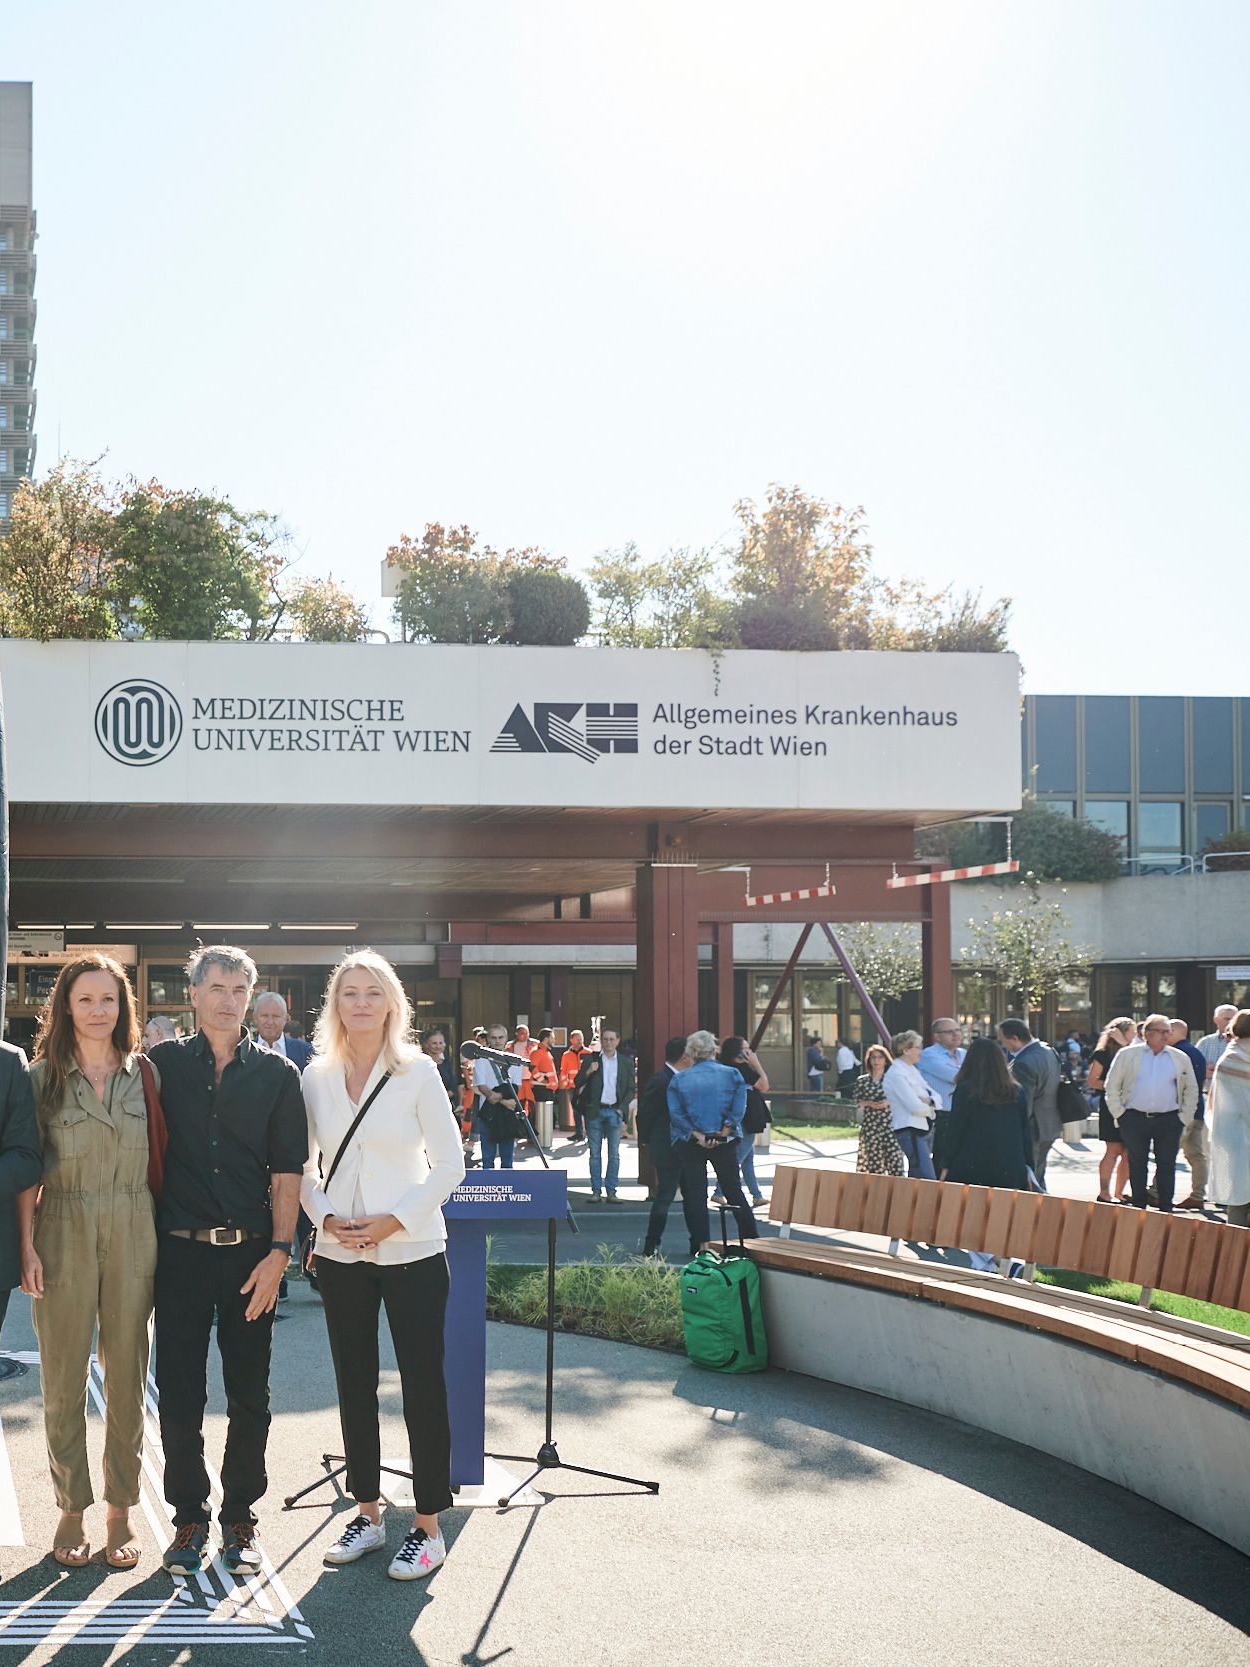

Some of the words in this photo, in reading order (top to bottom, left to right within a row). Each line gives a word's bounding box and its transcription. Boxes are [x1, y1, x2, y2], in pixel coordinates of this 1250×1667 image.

[192, 697, 405, 722] MEDIZINISCHE
[652, 703, 797, 730] Allgemeines
[805, 704, 958, 728] Krankenhaus
[193, 725, 385, 752] UNIVERSITÄT
[392, 730, 472, 753] WIEN
[653, 734, 691, 755] der
[698, 734, 764, 756] Stadt
[769, 735, 827, 757] Wien
[452, 1192, 507, 1202] UNIVERSITÄT
[508, 1194, 531, 1202] WIEN
[453, 1185, 513, 1193] MEDIZINISCHE
